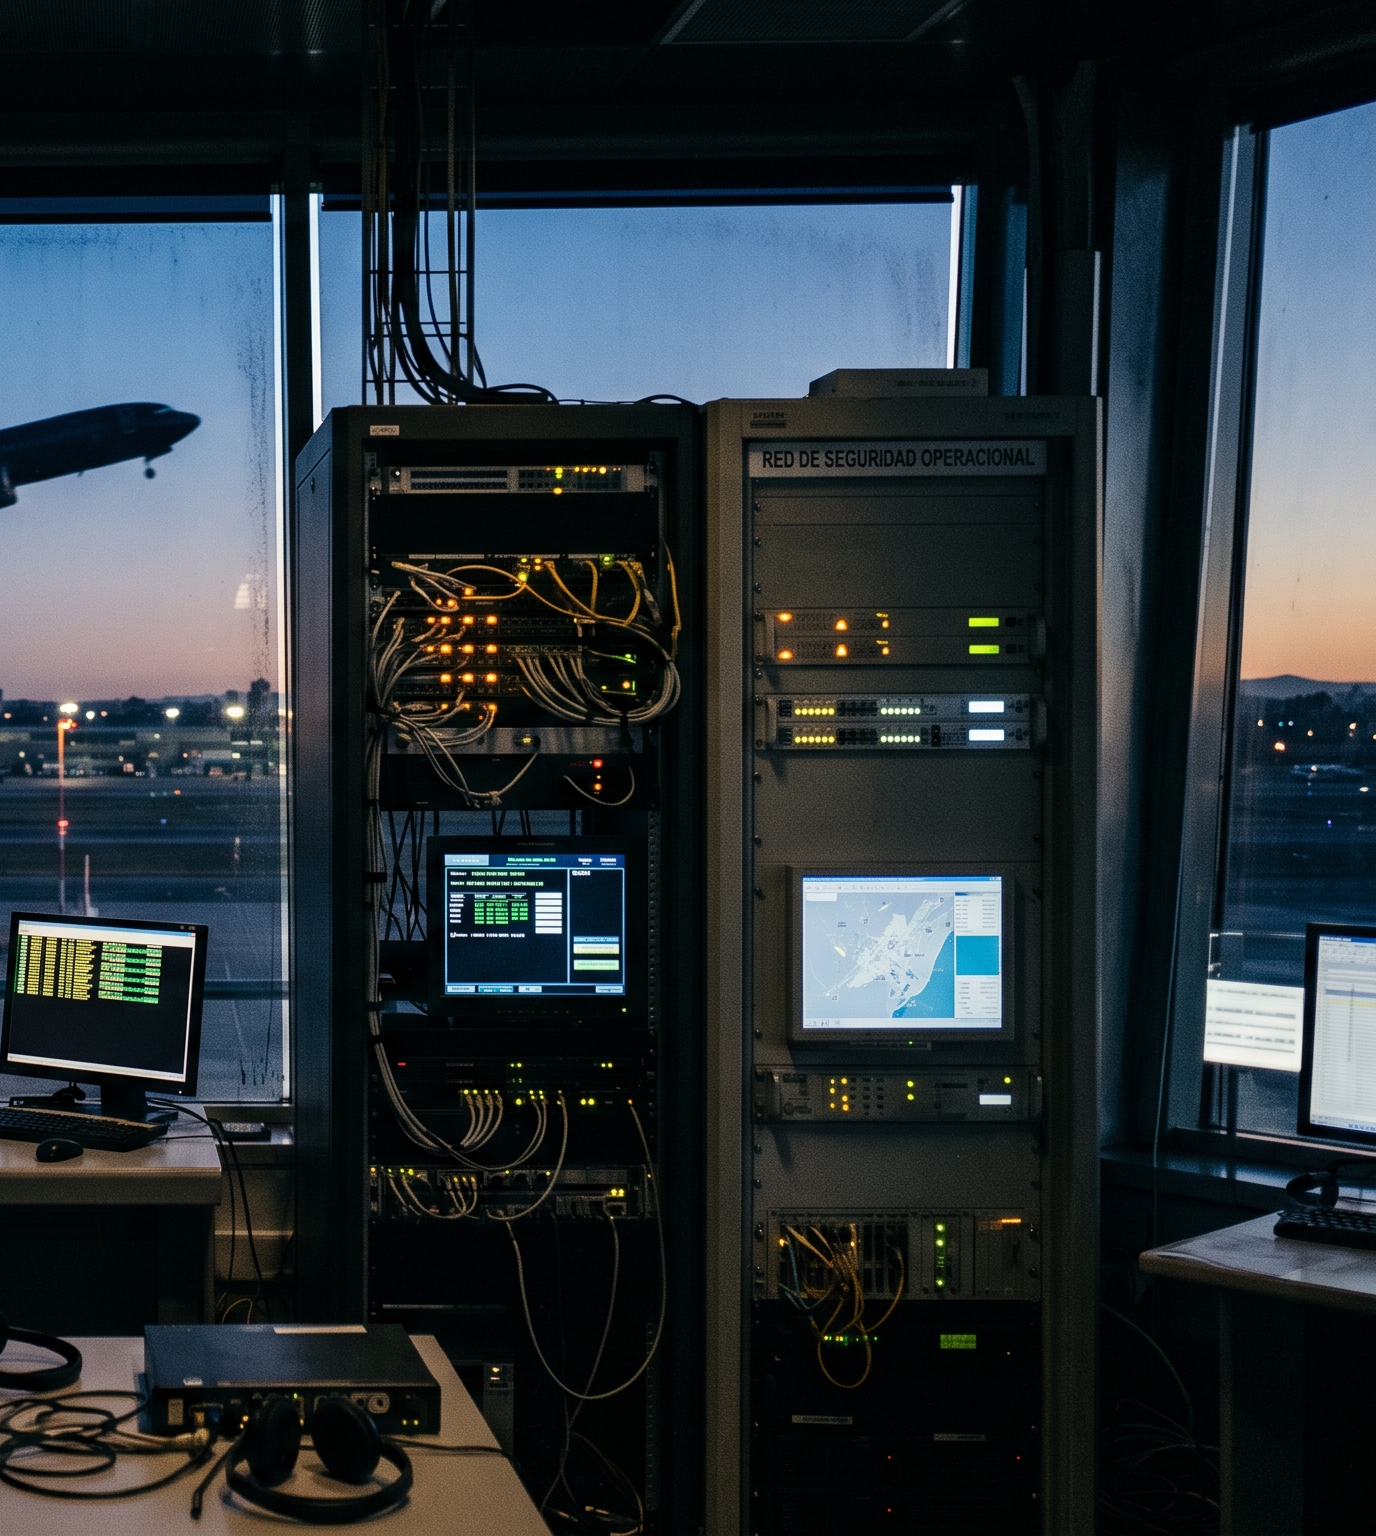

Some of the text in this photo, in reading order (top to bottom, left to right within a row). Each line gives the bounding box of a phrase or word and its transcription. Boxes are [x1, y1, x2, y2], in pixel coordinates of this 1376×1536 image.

[762, 447, 1036, 468] RED DE SEGURIDAD OPERACIONAL
